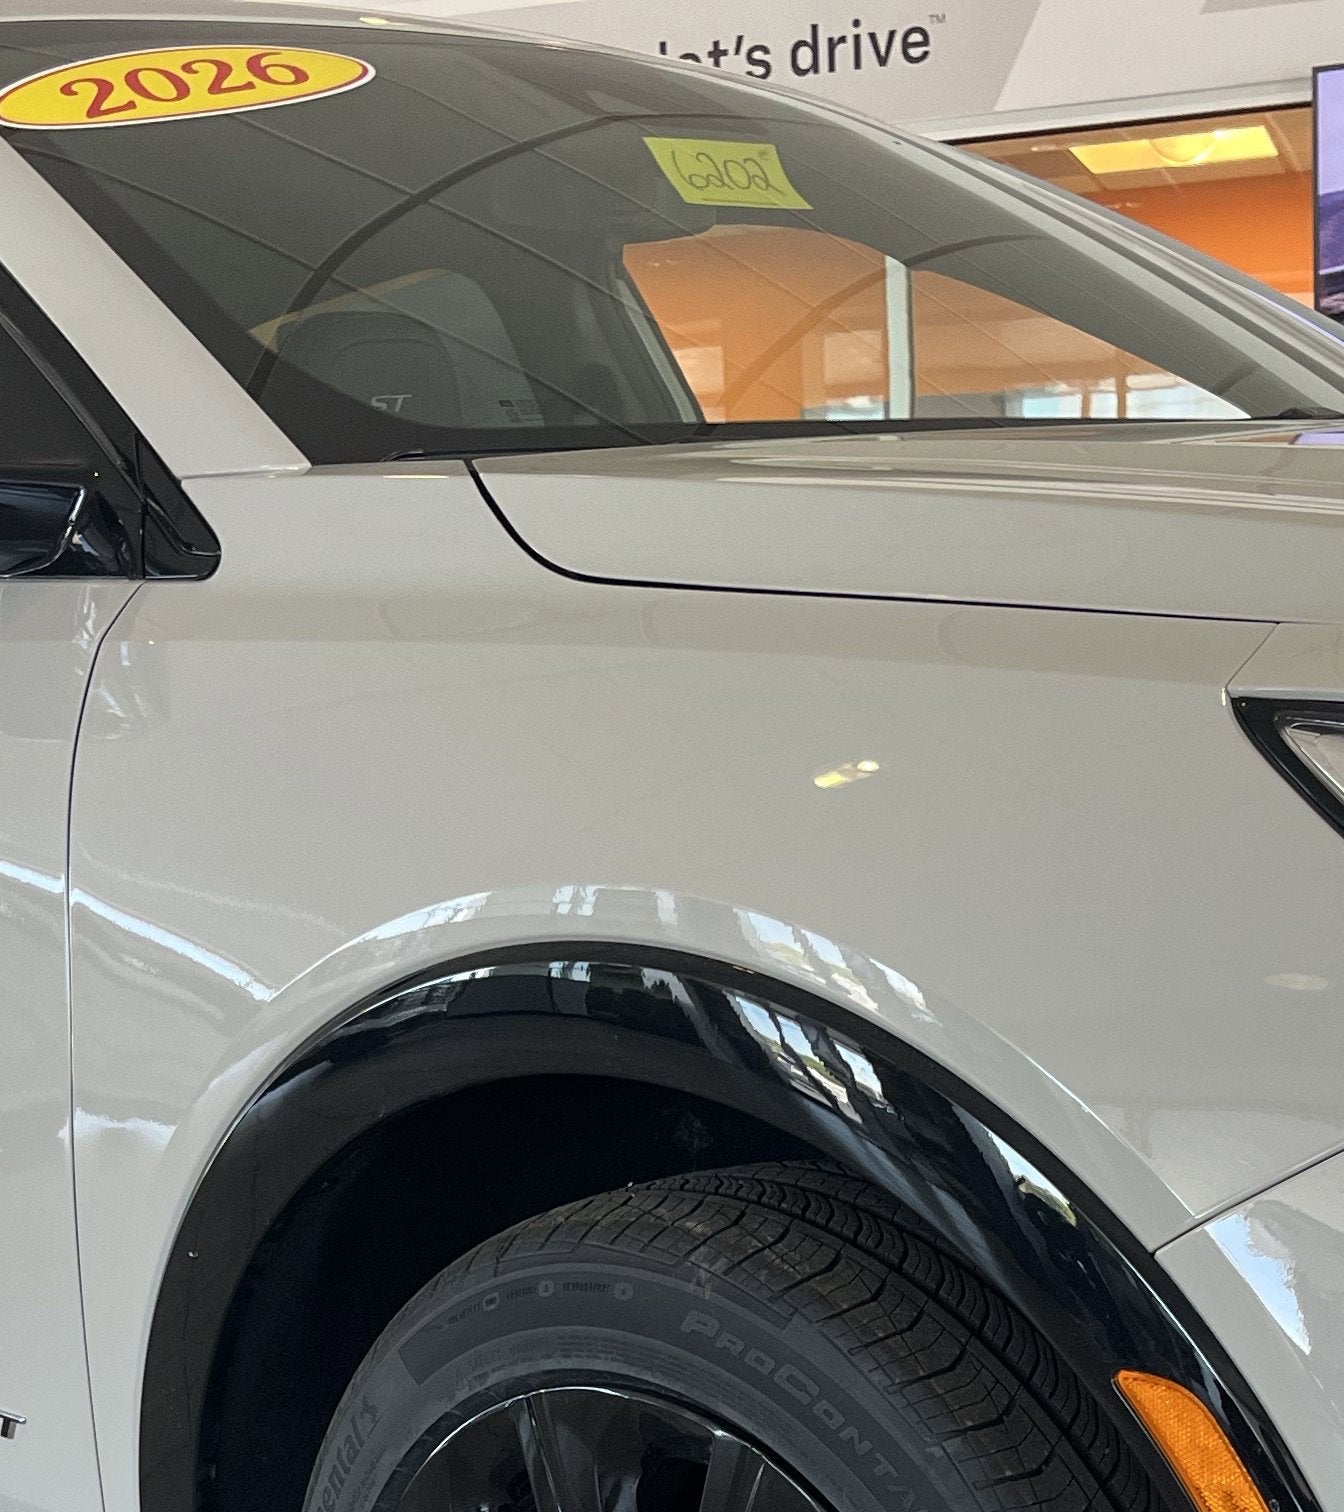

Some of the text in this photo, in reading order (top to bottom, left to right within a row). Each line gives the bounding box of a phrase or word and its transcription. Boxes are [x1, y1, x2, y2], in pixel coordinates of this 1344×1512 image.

[59, 51, 309, 119] 2026
[670, 149, 785, 195] 6202
[370, 393, 414, 413] ST
